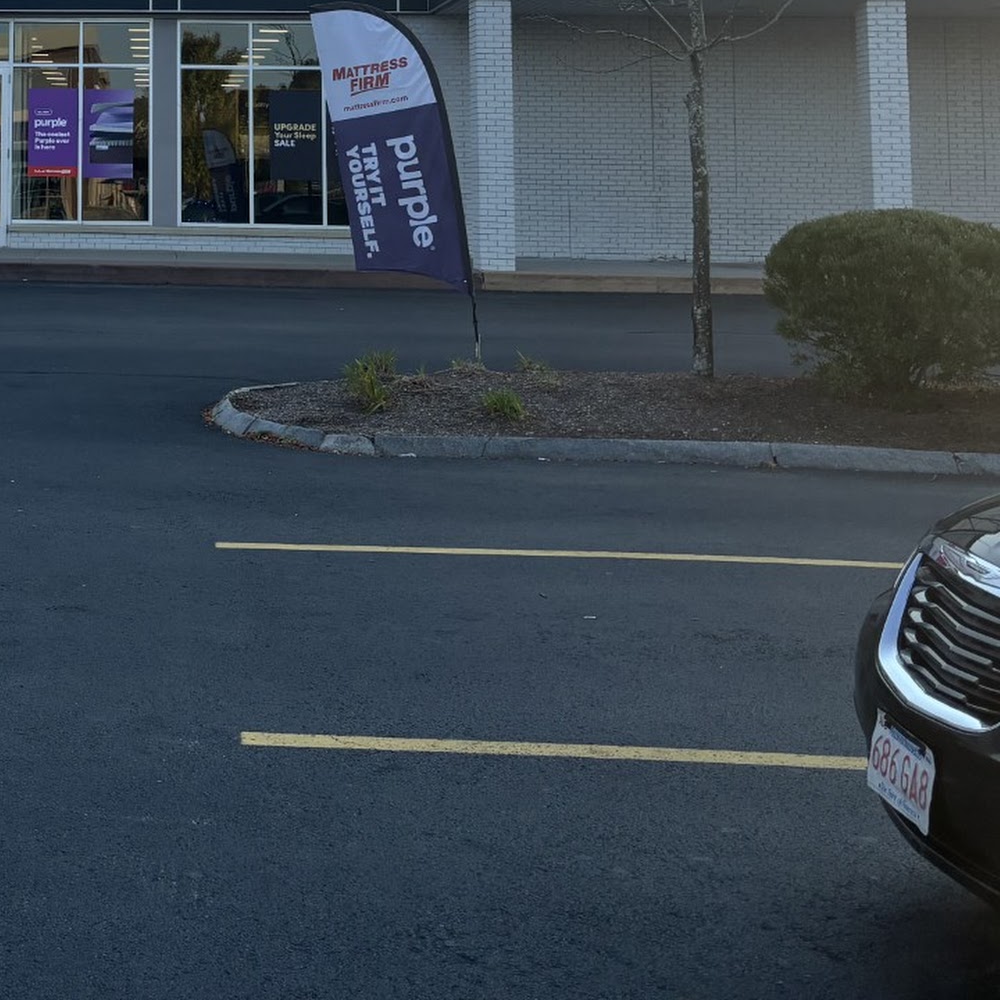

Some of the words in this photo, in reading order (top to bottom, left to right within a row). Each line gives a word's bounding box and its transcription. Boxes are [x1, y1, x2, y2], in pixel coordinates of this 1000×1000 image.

[332, 56, 408, 81] MATTRESS
[350, 71, 392, 93] FIRM
[34, 118, 67, 128] purple
[274, 123, 317, 131] UPGRADE
[293, 131, 317, 140] Sleep
[361, 142, 381, 183] TRY
[345, 144, 380, 259] YOURSELF.
[369, 186, 387, 207] IT
[386, 135, 438, 248] purple
[872, 736, 899, 785] 686
